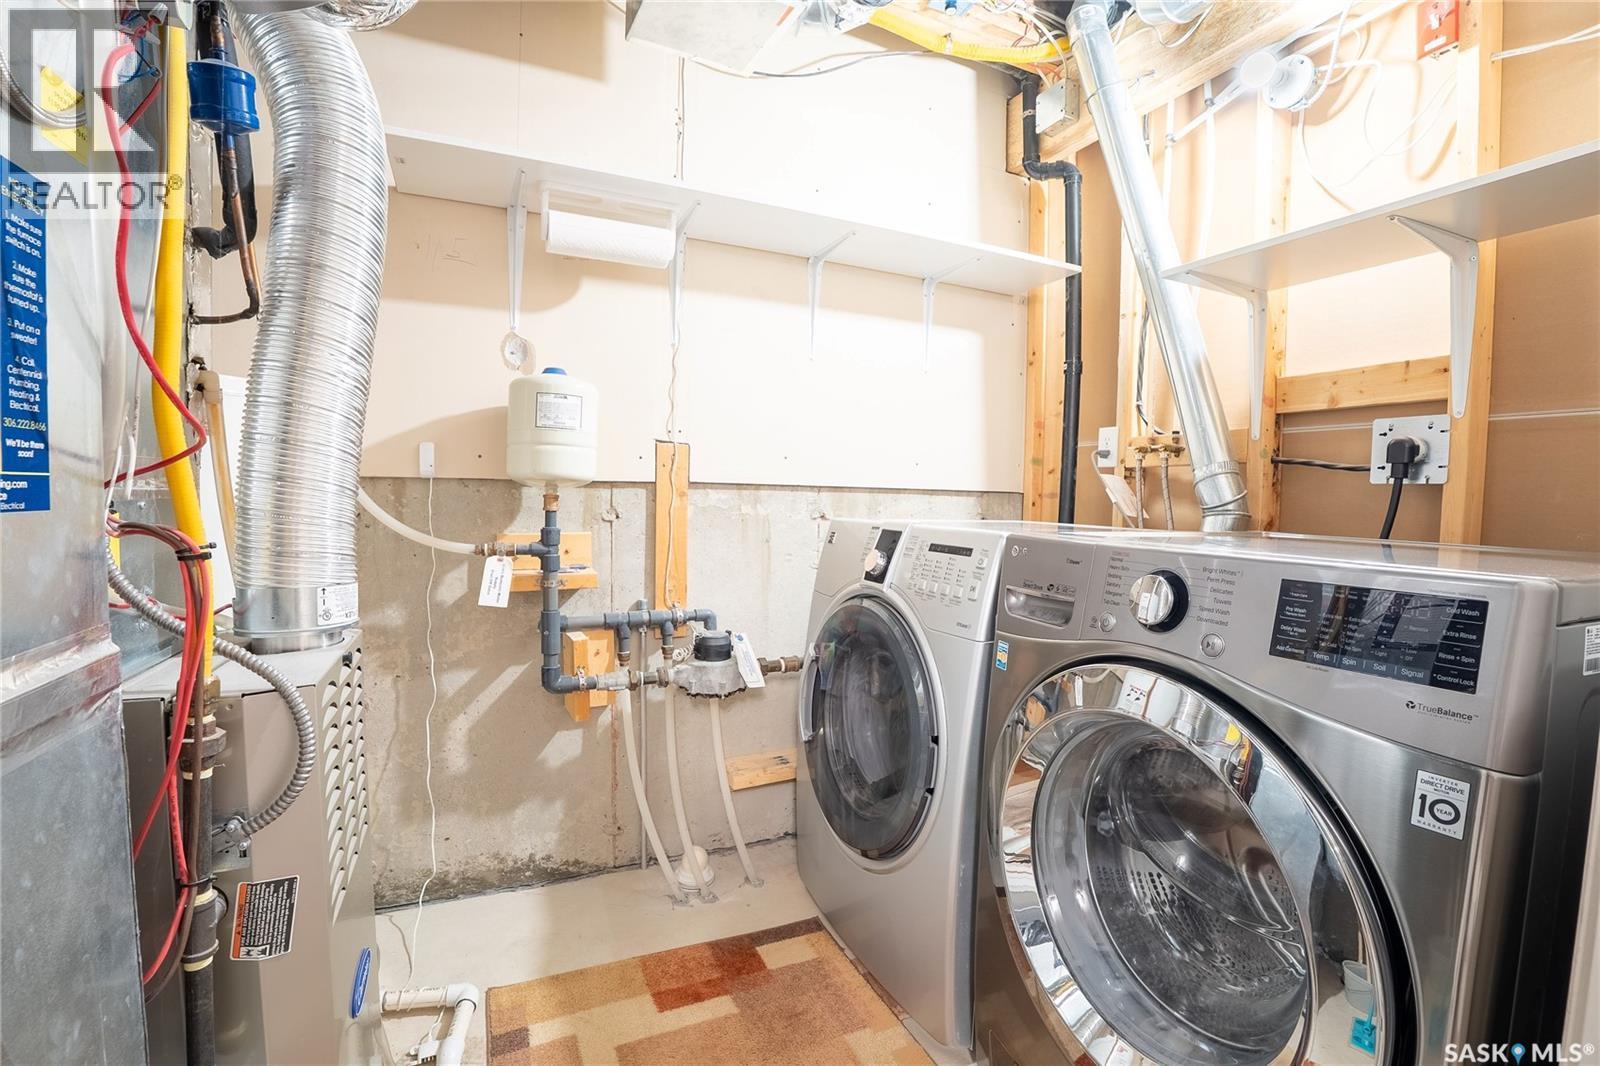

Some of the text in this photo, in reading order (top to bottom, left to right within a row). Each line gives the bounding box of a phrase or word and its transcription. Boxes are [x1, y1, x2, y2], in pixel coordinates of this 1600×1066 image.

[11, 213, 29, 230] Make
[30, 224, 43, 236] sure
[5, 222, 42, 247] the furnace
[5, 235, 25, 250] switch
[18, 263, 37, 278] Make
[12, 273, 37, 290] sure the
[4, 281, 38, 301] thermostat
[7, 294, 29, 309] turned
[14, 319, 25, 331] Put
[26, 325, 35, 334] on
[7, 364, 43, 380] Centennial
[8, 388, 35, 402] Heating
[21, 439, 30, 448] be
[30, 440, 45, 450] there
[17, 450, 34, 458] soon!
[1446, 606, 1480, 617] Cold Wash
[1442, 629, 1477, 640] Extra Rinse
[1313, 651, 1330, 661] Temp
[1342, 657, 1357, 666] Spin
[1438, 651, 1455, 661] Rinse
[1461, 655, 1475, 664] Spin
[1373, 663, 1386, 672] Soil
[1401, 668, 1424, 679] Signal
[1437, 674, 1475, 686] Control Lock
[1420, 777, 1465, 796] DIRECT DRIVE
[1418, 793, 1461, 826] 10
[1435, 807, 1453, 817] YEAR
[1417, 819, 1457, 835] WARRANTY
